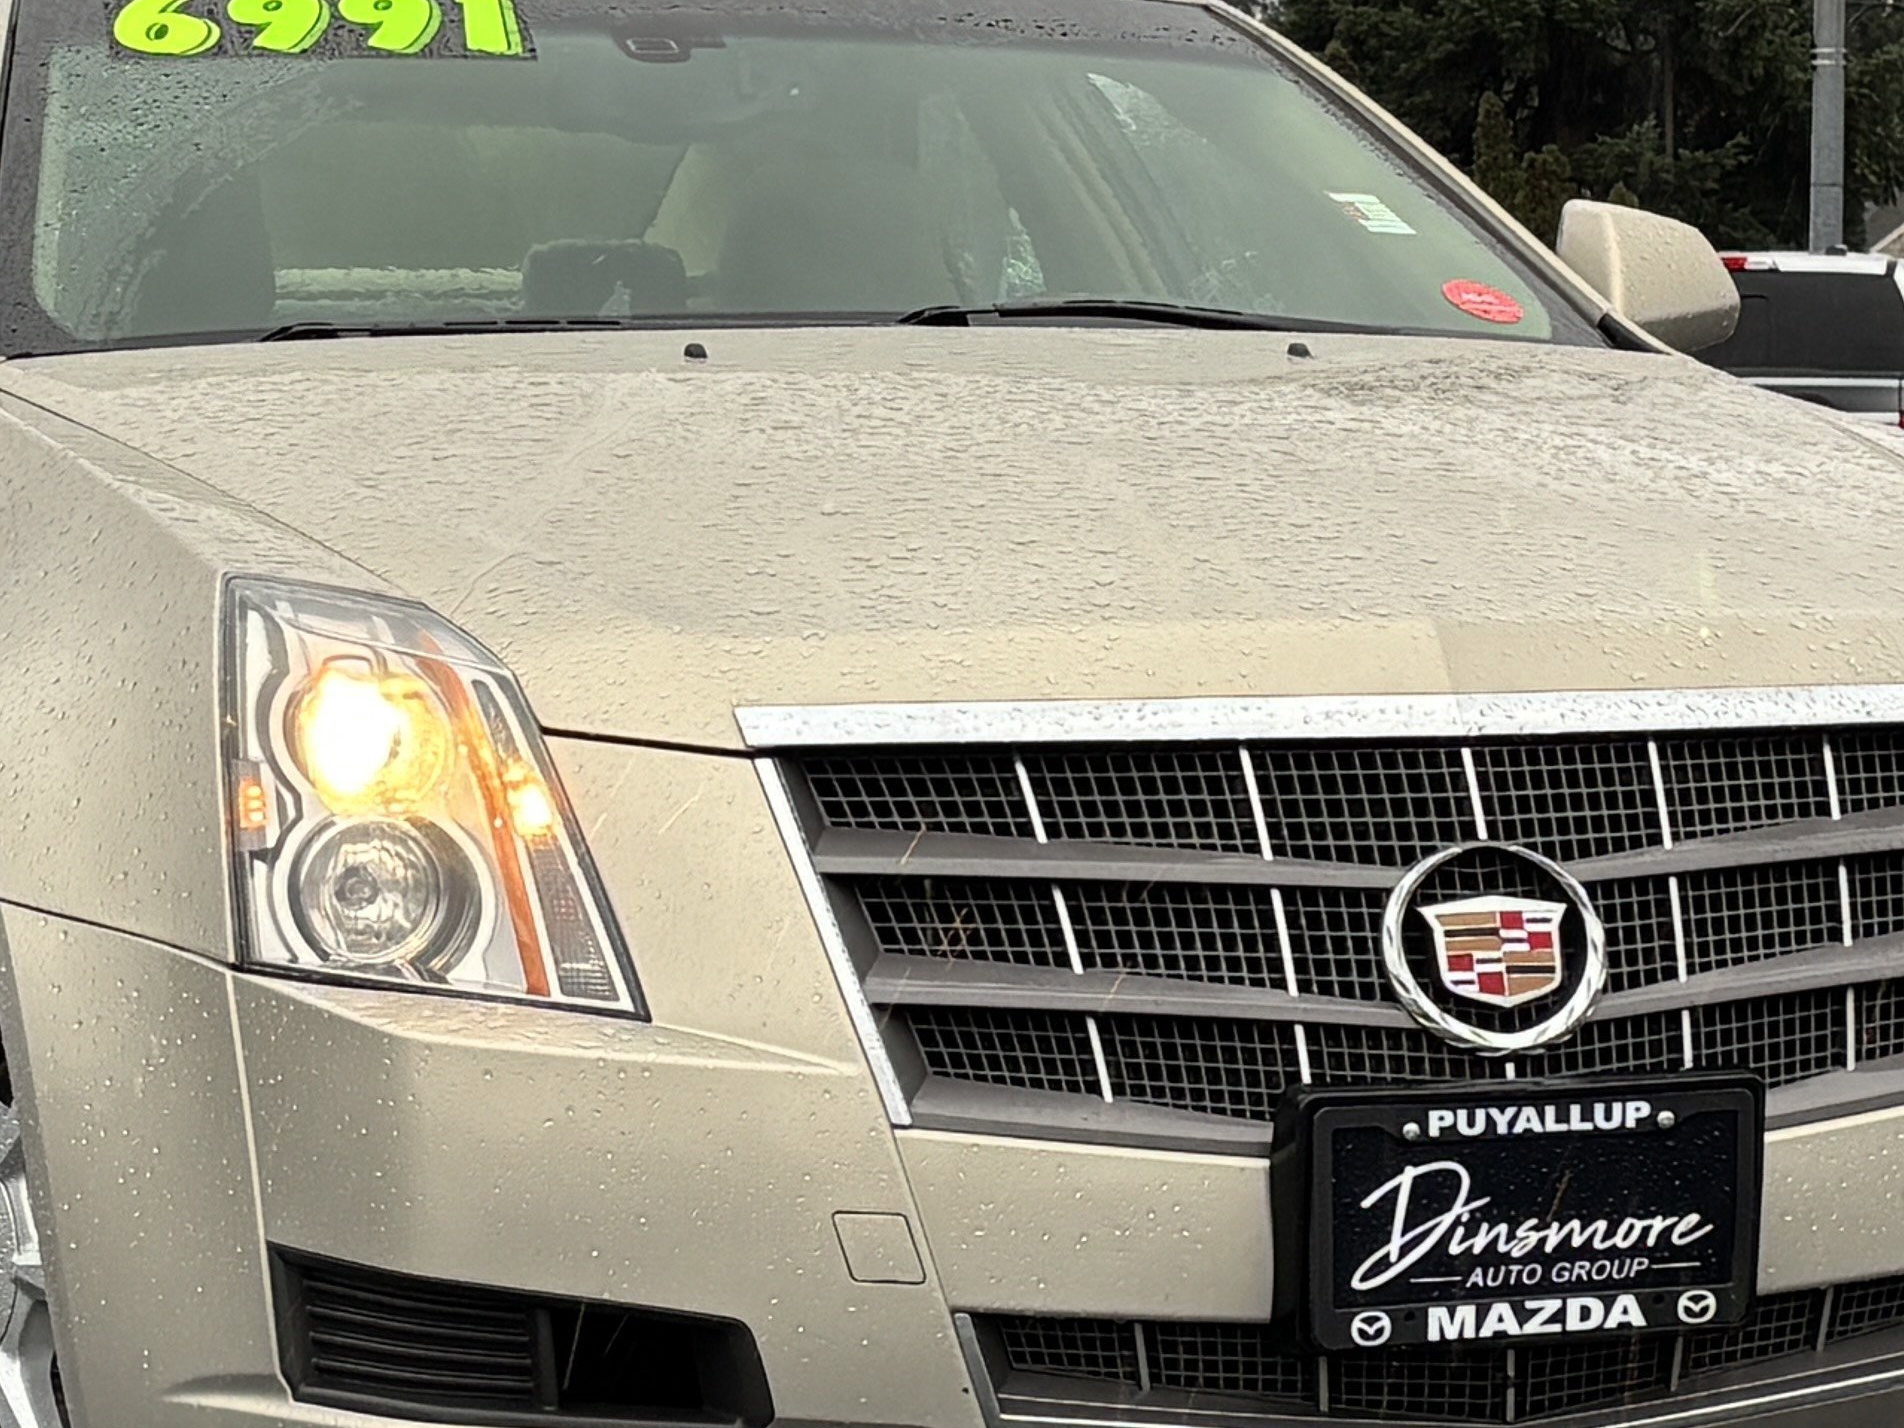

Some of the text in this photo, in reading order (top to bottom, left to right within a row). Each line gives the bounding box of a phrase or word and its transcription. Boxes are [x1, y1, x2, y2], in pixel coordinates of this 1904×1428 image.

[1427, 1100, 1652, 1138] PUYALLUP
[1350, 1160, 1714, 1291] Dinsmore
[1465, 1257, 1650, 1289] AUTO GROUP
[1426, 1293, 1648, 1342] MAZDA
